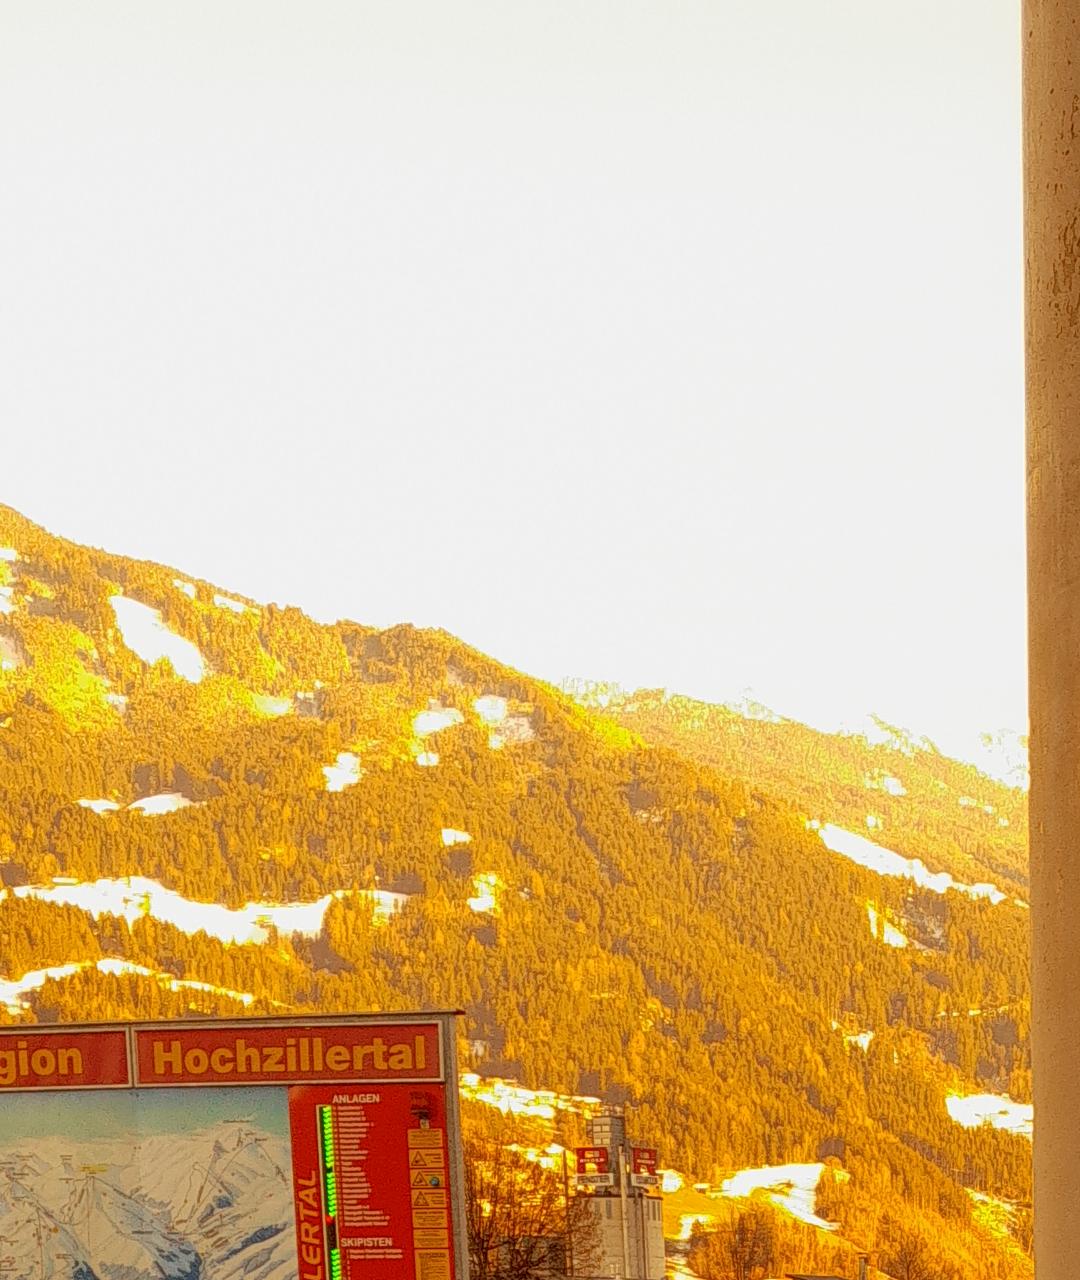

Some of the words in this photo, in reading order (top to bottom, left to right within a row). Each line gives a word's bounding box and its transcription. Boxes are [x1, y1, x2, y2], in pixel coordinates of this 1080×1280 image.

[153, 1036, 426, 1075] Hochzillertal
[332, 1093, 380, 1104] ANLAGEN
[340, 1237, 393, 1248] SKIPISTEN
